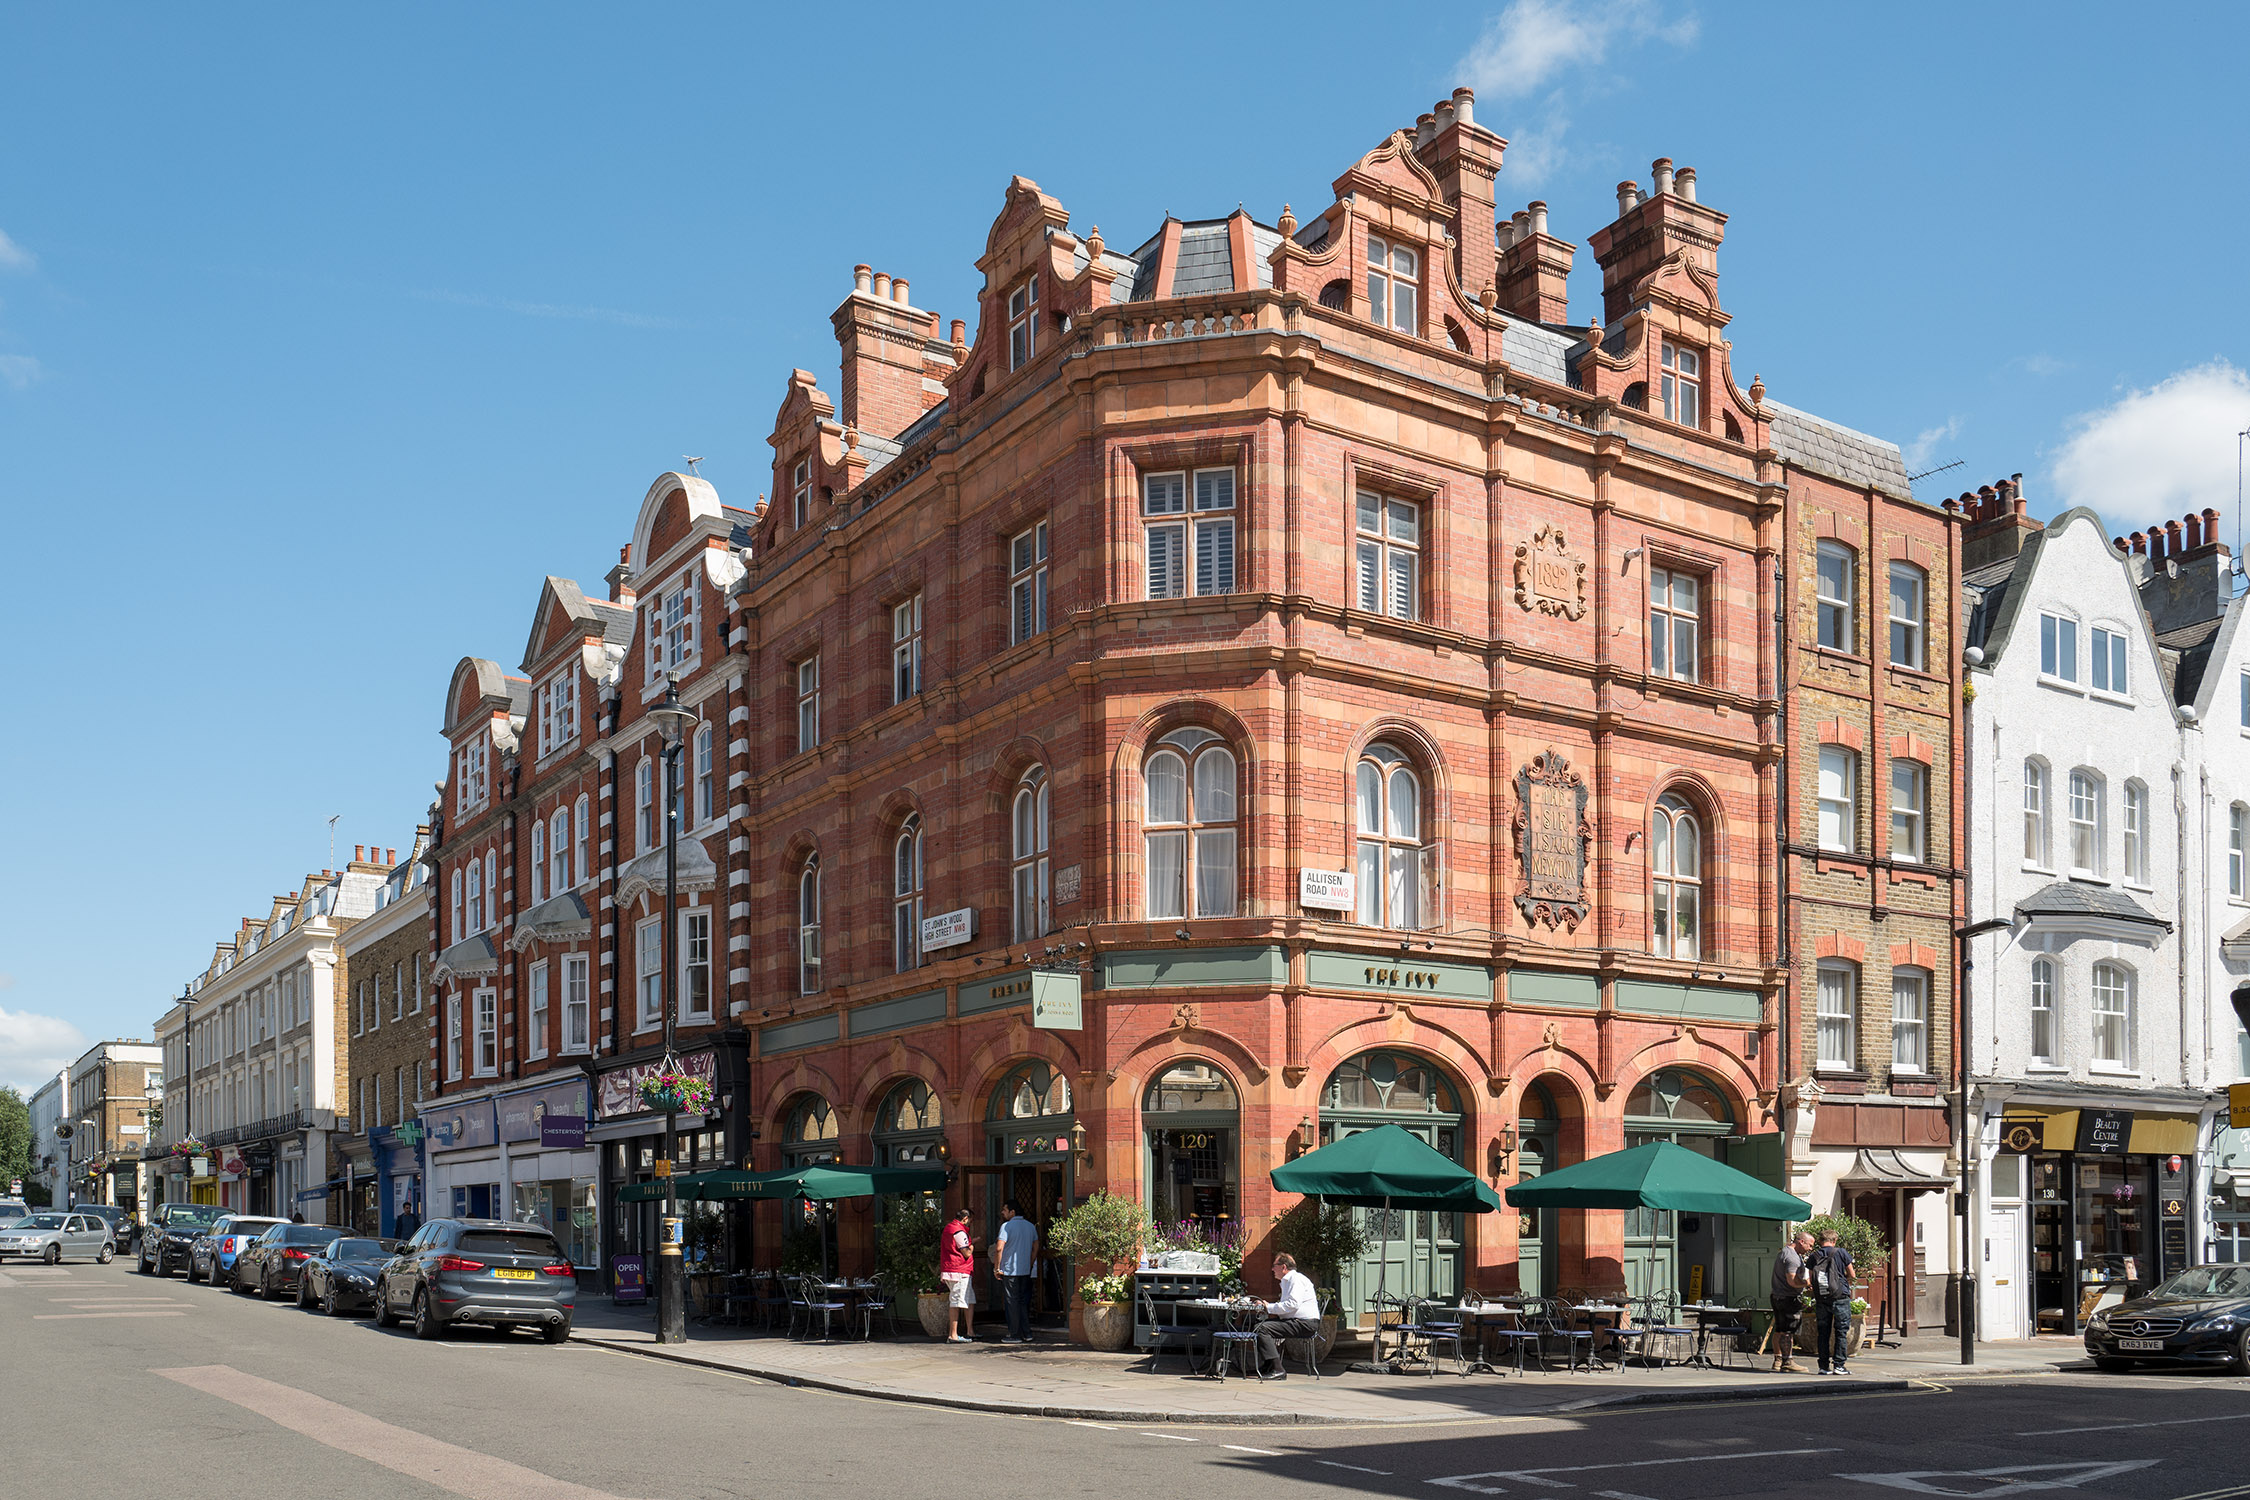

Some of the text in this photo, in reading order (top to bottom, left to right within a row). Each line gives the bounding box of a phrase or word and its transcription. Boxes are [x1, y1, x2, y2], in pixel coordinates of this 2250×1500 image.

[1537, 562, 1567, 592] 1892
[1542, 787, 1565, 807] THE
[1542, 810, 1568, 832] SIR
[1535, 833, 1576, 856] ISAAC
[1533, 856, 1576, 880] NEWTON
[1306, 872, 1342, 885] ALLITSEN
[1306, 884, 1349, 898] ROAD NW8
[949, 913, 962, 924] WOOD
[925, 922, 966, 940] HIGH STREET NW8
[1365, 967, 1440, 986] THE IVY
[989, 980, 1031, 998] THE IV
[552, 1103, 570, 1117] beauty
[471, 1119, 486, 1130] beauty
[505, 1111, 529, 1127] pharmacy
[2095, 1118, 2121, 1130] BEAUTY
[1180, 1134, 1207, 1149] 120
[2093, 1129, 2119, 1141] CENTRE
[644, 1186, 655, 1195] THE
[731, 1182, 763, 1191] THE IVY
[2043, 1189, 2055, 1199] 130
[498, 1269, 515, 1277] LG16
[618, 1264, 640, 1272] OPEN
[2143, 1341, 2159, 1349] BVE
